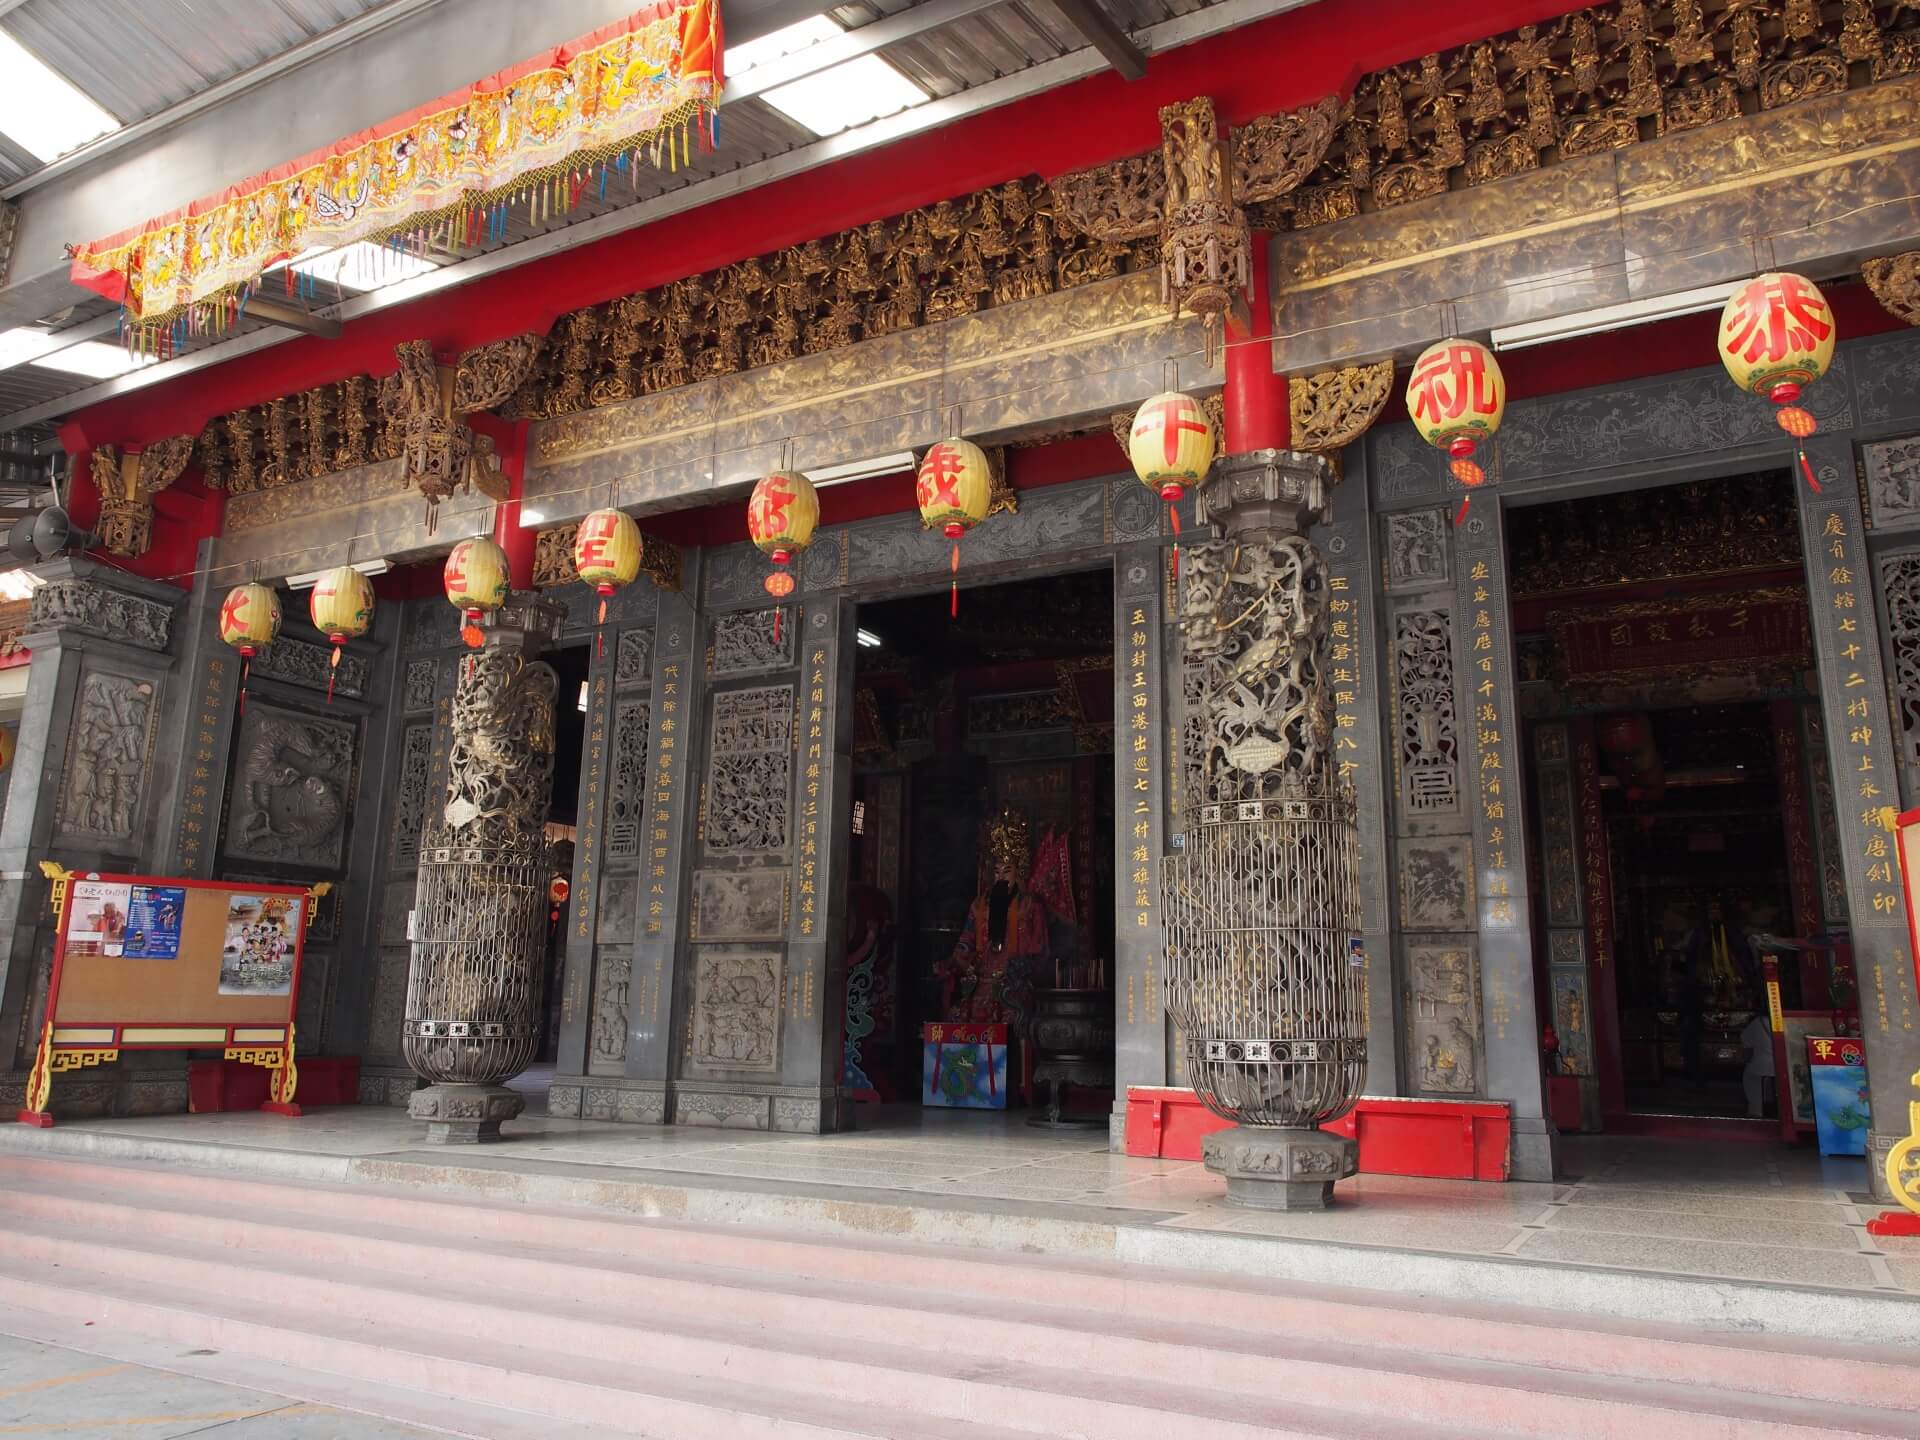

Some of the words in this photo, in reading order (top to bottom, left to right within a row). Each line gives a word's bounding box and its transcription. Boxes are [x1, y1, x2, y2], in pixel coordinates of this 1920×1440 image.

[1726, 273, 1832, 364] 恭
[1410, 345, 1499, 424] 祝
[1136, 399, 1207, 466] 千
[1813, 1039, 1837, 1062] 軍
